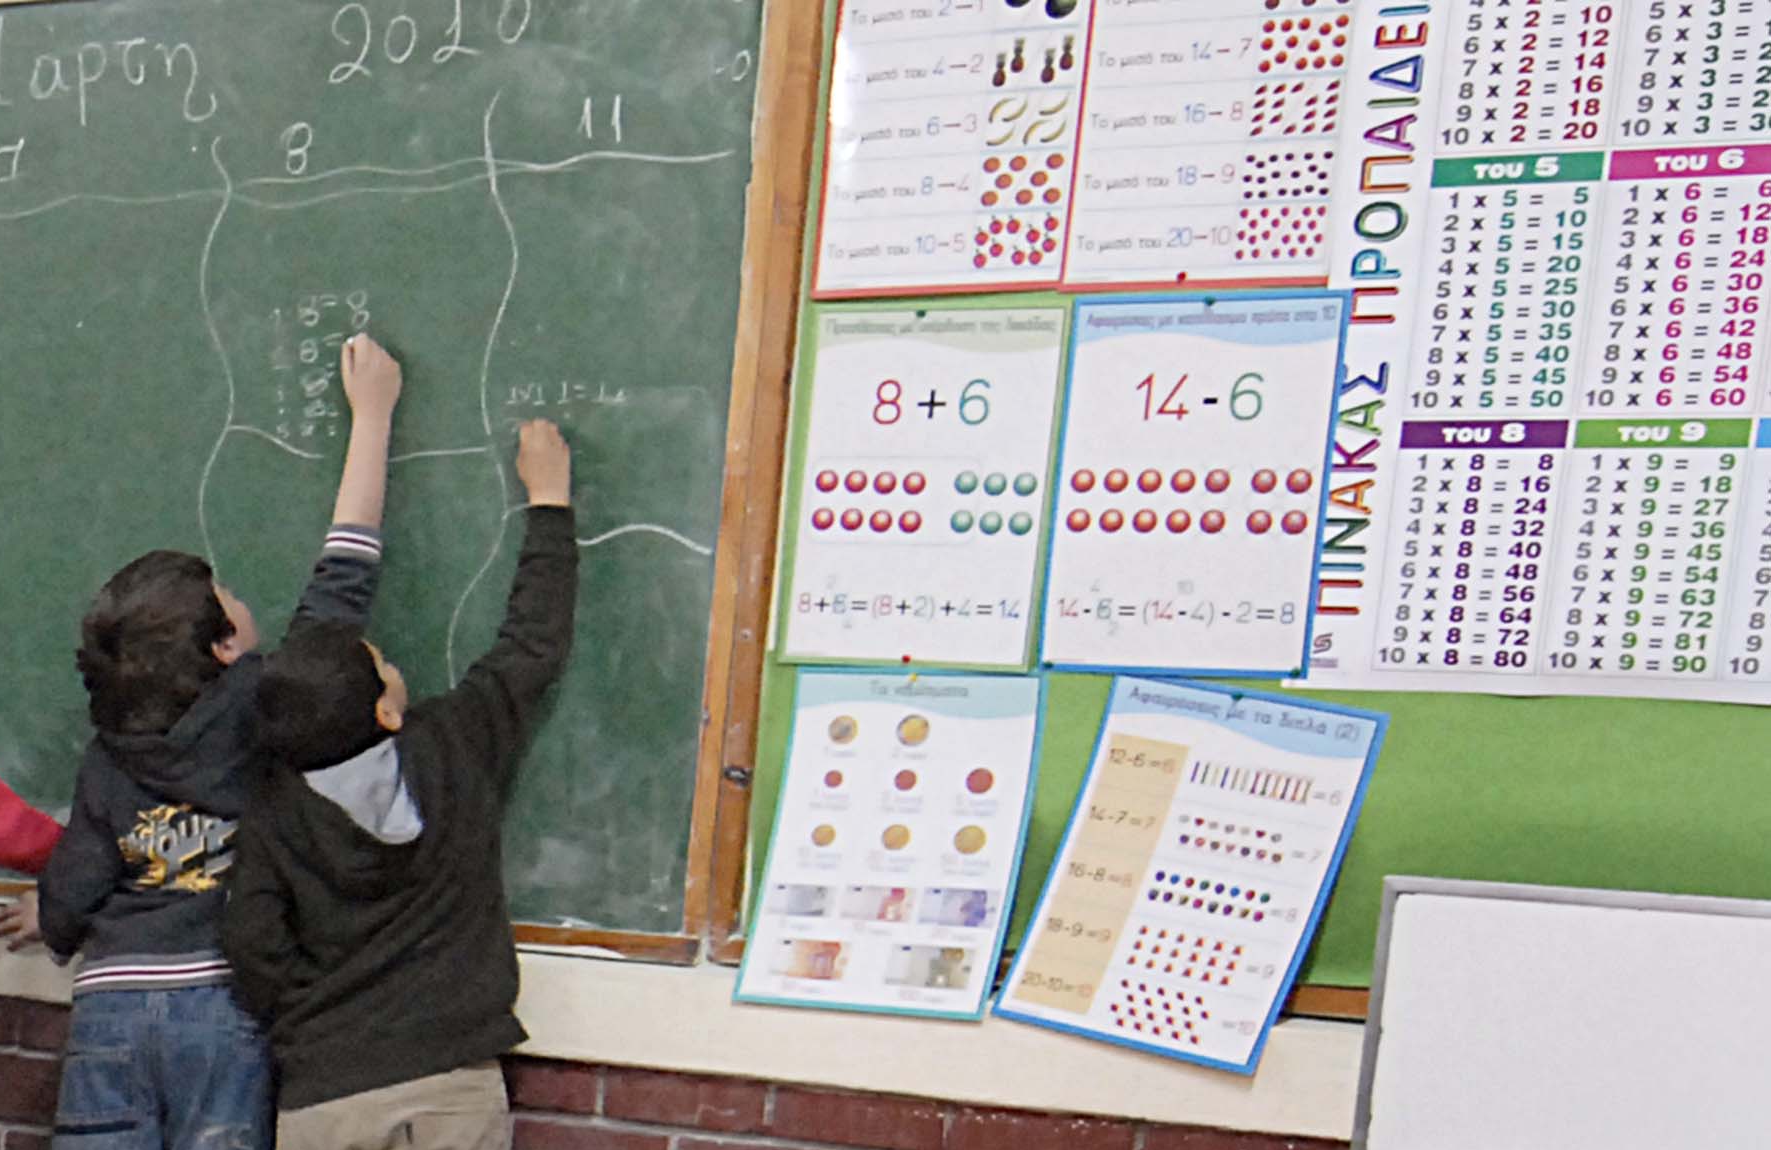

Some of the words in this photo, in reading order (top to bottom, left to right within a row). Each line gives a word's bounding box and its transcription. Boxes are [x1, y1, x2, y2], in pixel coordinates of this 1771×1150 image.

[1469, 15, 1482, 31] 5
[1495, 17, 1508, 30] x
[1525, 11, 1540, 28] 2
[1581, 6, 1613, 24] 10
[1458, 106, 1472, 122] 9
[1485, 109, 1497, 121] x
[1513, 103, 1529, 120] 2
[1570, 99, 1600, 117] 18
[1443, 128, 1469, 145] 10
[1482, 131, 1495, 144] x
[1510, 125, 1526, 142] 2
[1563, 122, 1598, 140] 20
[1534, 157, 1560, 177] 5
[1718, 149, 1745, 170] 6
[1451, 193, 1459, 208] 1
[1474, 196, 1487, 208] x
[1503, 190, 1518, 207] 5
[1575, 188, 1589, 205] 5
[1623, 209, 1639, 225] 2
[1652, 212, 1666, 224] x
[1682, 206, 1698, 224] 6
[1741, 204, 1771, 222] 12
[1439, 260, 1453, 275] 4
[1466, 263, 1478, 275] x
[1496, 258, 1510, 275] 5
[1548, 256, 1581, 273] 20
[1615, 277, 1629, 294] 5
[1642, 281, 1656, 293] x
[1672, 275, 1688, 293] 6
[1727, 273, 1763, 291] 30
[1433, 326, 1446, 342] 7
[1458, 330, 1471, 342] x
[1487, 325, 1502, 342] 5
[1540, 323, 1572, 341] 35
[1412, 393, 1438, 408] 10
[1451, 396, 1463, 408] x
[1480, 391, 1494, 408] 5
[1531, 391, 1563, 408] 50
[1587, 390, 1614, 406] 10
[1627, 395, 1640, 406] x
[1656, 390, 1672, 407] 6
[1711, 388, 1746, 406] 60
[1500, 423, 1526, 443] 8
[1680, 421, 1706, 441] 9
[1419, 455, 1427, 470] 1
[1443, 459, 1455, 471] x
[1470, 455, 1485, 471] 8
[1538, 454, 1554, 471] 8
[1316, 362, 1390, 615] ΠΙΝΑΚΑΣ
[1586, 477, 1601, 492] 2
[1614, 481, 1627, 493] x
[1645, 477, 1660, 493] 9
[1701, 477, 1732, 493] 18
[1405, 541, 1418, 556] 5
[1431, 546, 1443, 557] x
[1458, 542, 1473, 558] 8
[1509, 542, 1542, 559] 40
[1381, 648, 1405, 663] 10
[1418, 653, 1429, 664] x
[1444, 650, 1459, 666] 8
[1494, 651, 1527, 668] 80
[1550, 653, 1577, 668] 10
[1590, 658, 1603, 670] x
[1620, 655, 1635, 670] 9
[1673, 656, 1707, 673] 90
